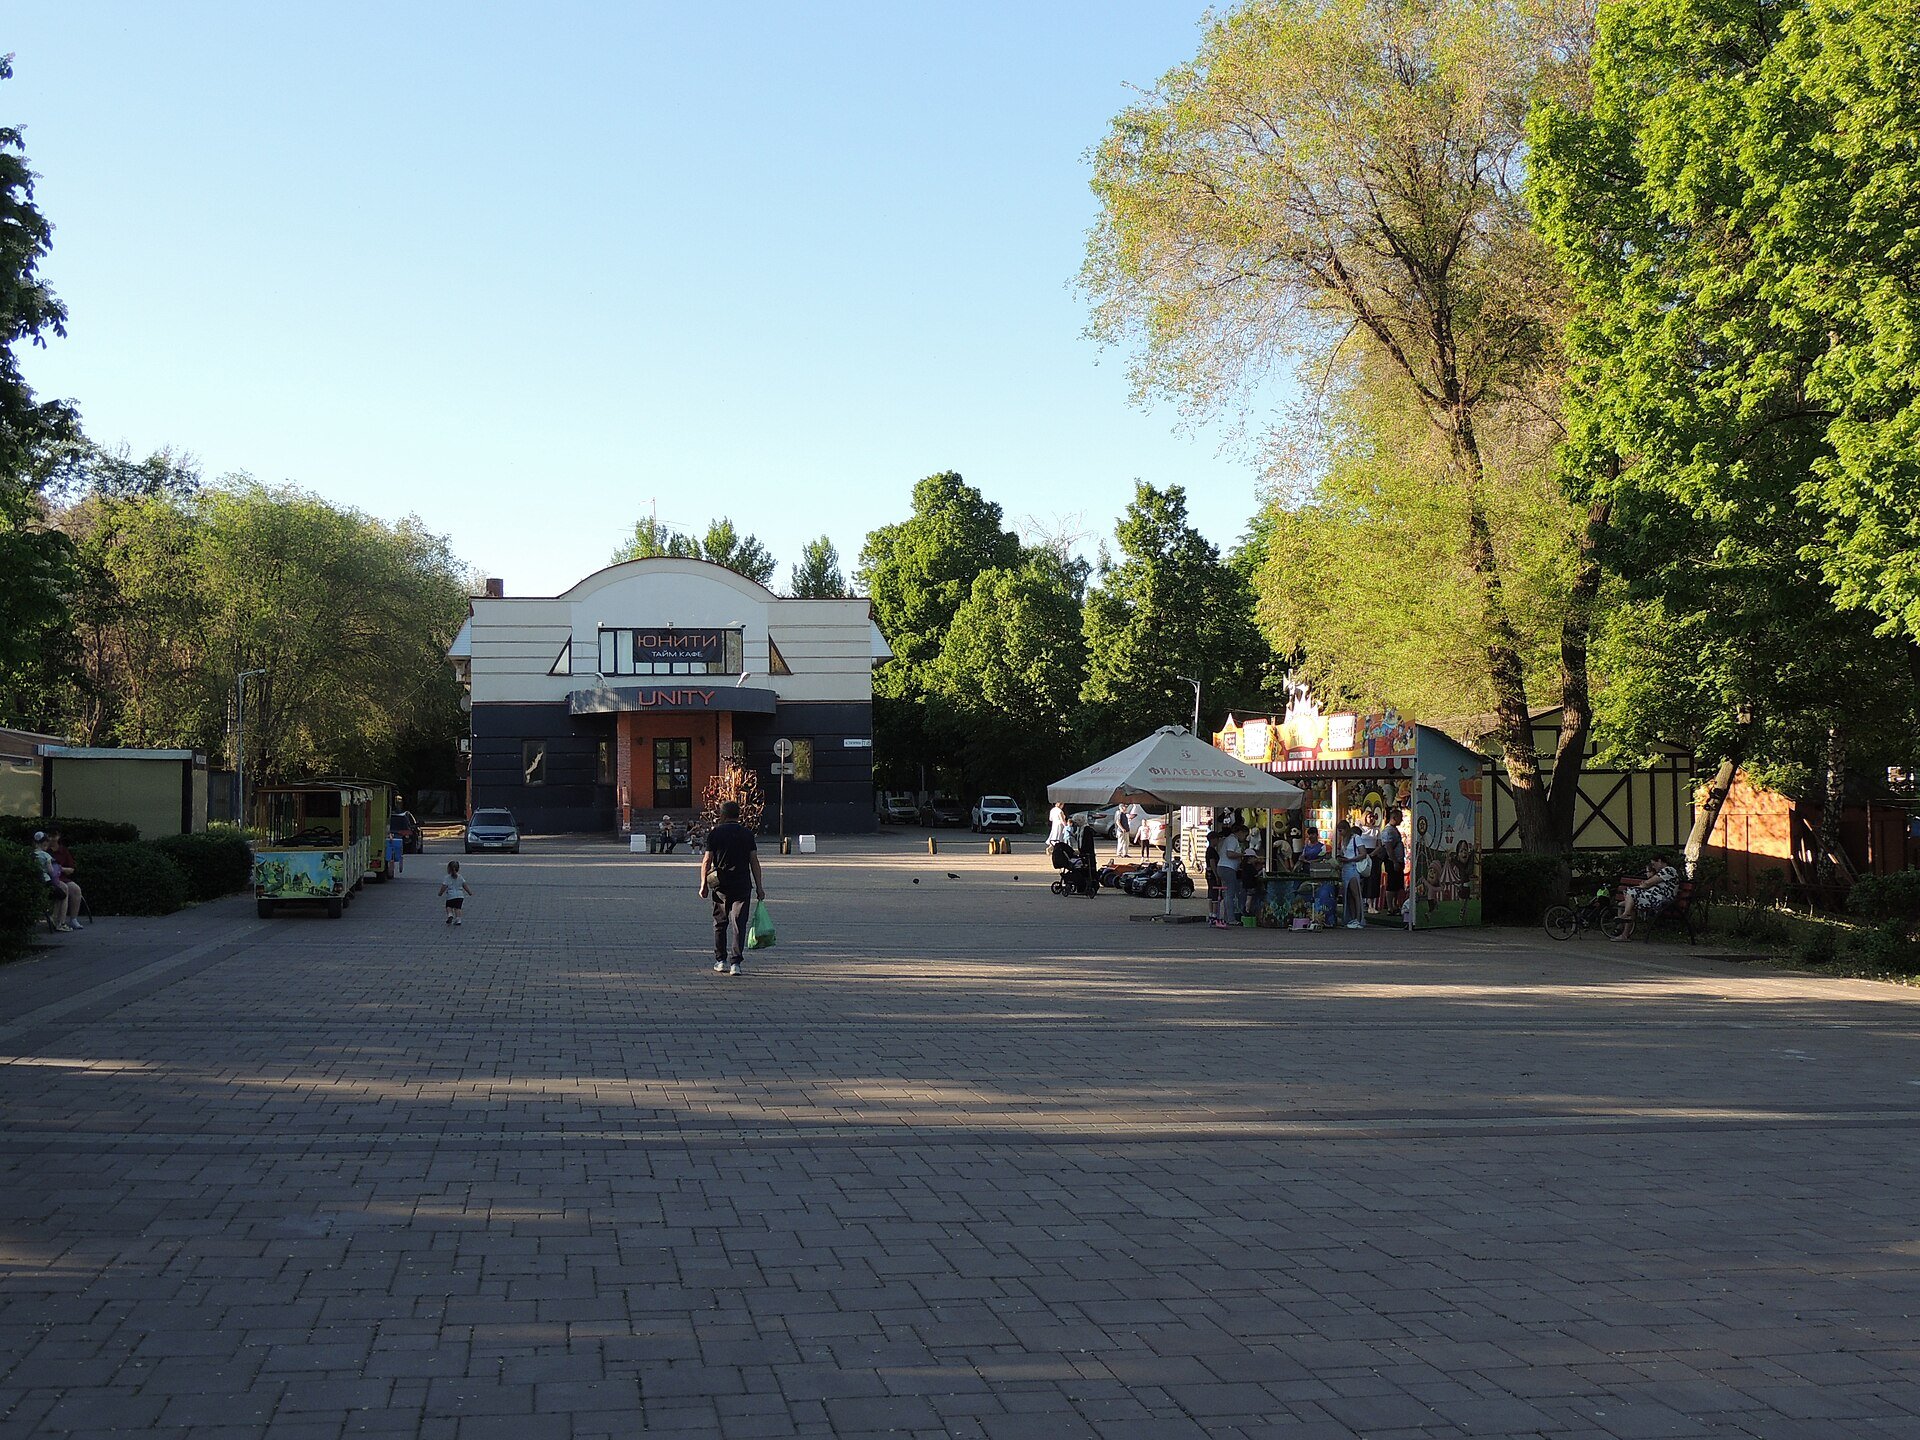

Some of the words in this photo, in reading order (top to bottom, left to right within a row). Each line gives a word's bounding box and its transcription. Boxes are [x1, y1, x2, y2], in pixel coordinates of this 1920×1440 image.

[638, 635, 717, 647] ЮНИТИ
[651, 649, 677, 657] ТАЙМ
[638, 690, 715, 705] UNITY
[1148, 766, 1246, 779] ФИЛЕВСКОЕ
